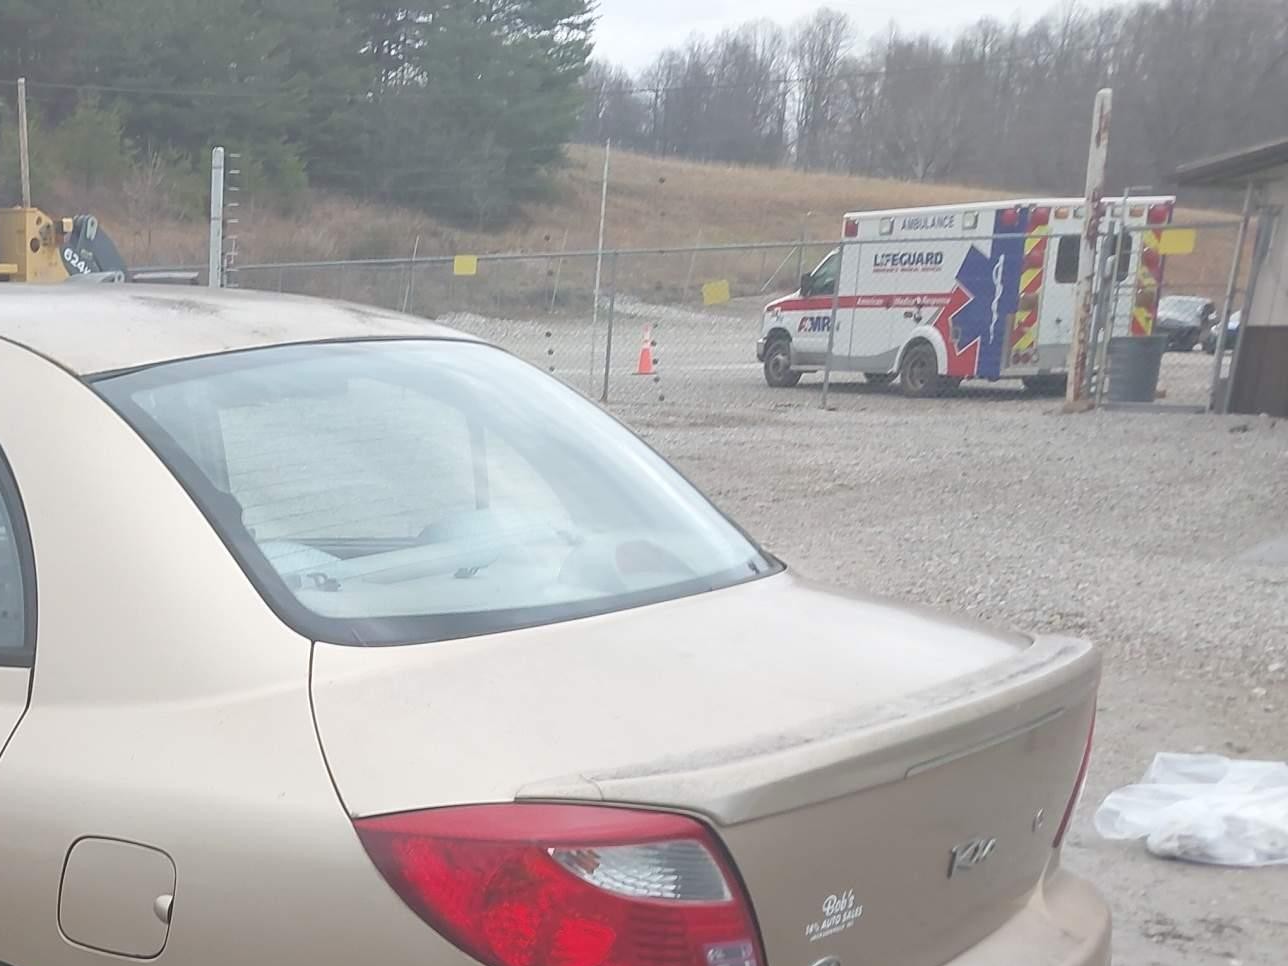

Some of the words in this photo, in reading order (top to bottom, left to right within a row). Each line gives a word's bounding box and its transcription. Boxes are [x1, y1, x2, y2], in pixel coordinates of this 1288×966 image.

[900, 215, 955, 231] AMBULANCE
[873, 250, 944, 267] LIFEGUARD
[797, 315, 831, 333] AMR
[822, 888, 855, 917] Bob's
